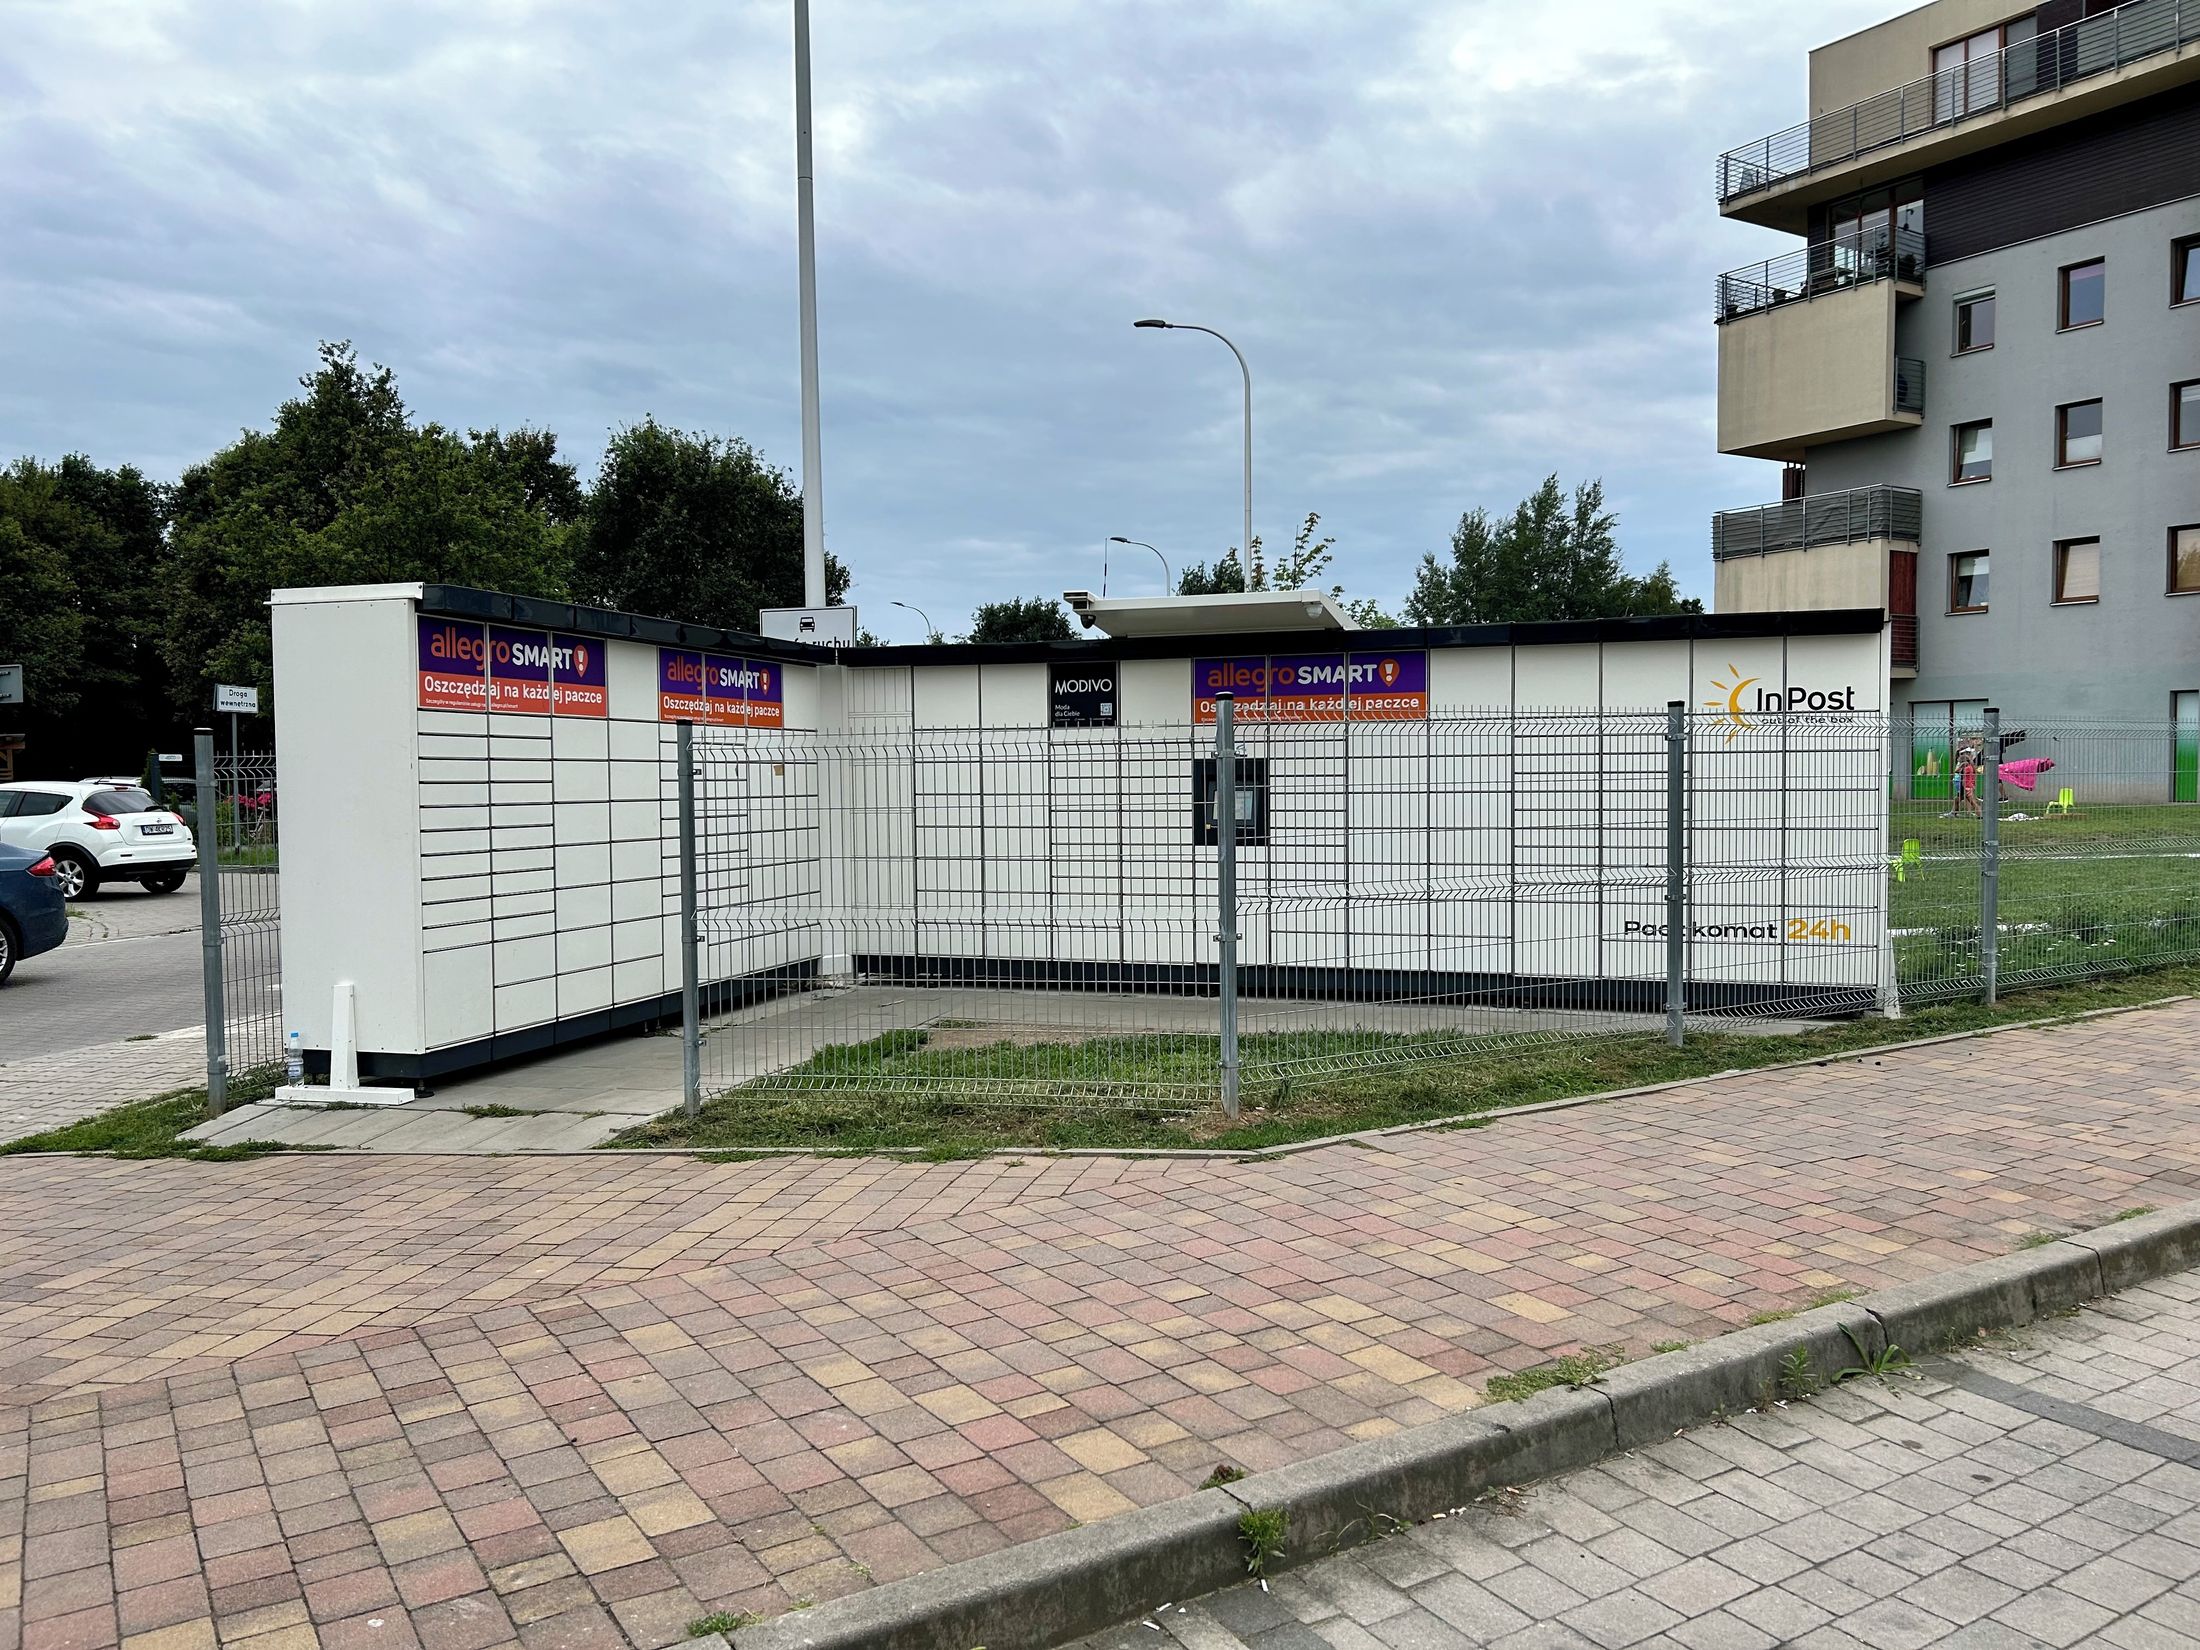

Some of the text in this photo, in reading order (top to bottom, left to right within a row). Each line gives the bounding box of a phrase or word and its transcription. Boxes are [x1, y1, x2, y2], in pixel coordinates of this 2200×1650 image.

[431, 626, 510, 671] allegro
[667, 655, 719, 691] allegro
[1207, 662, 1295, 693] allegro
[228, 689, 248, 699] Droga
[424, 676, 603, 704] Oszczędzaj na każdej paczce
[1055, 678, 1112, 695] MODIVO
[220, 700, 256, 708] wewnętrzna
[663, 695, 780, 718] Oszczędzaj na każdej paczce
[1287, 701, 1305, 711] na
[1309, 697, 1361, 711] każdej
[1365, 698, 1419, 711] paczce
[1757, 686, 1855, 711] InPost
[1805, 716, 1826, 724] the
[1830, 716, 1853, 724] box
[1624, 918, 1851, 940] Packomat 24h
